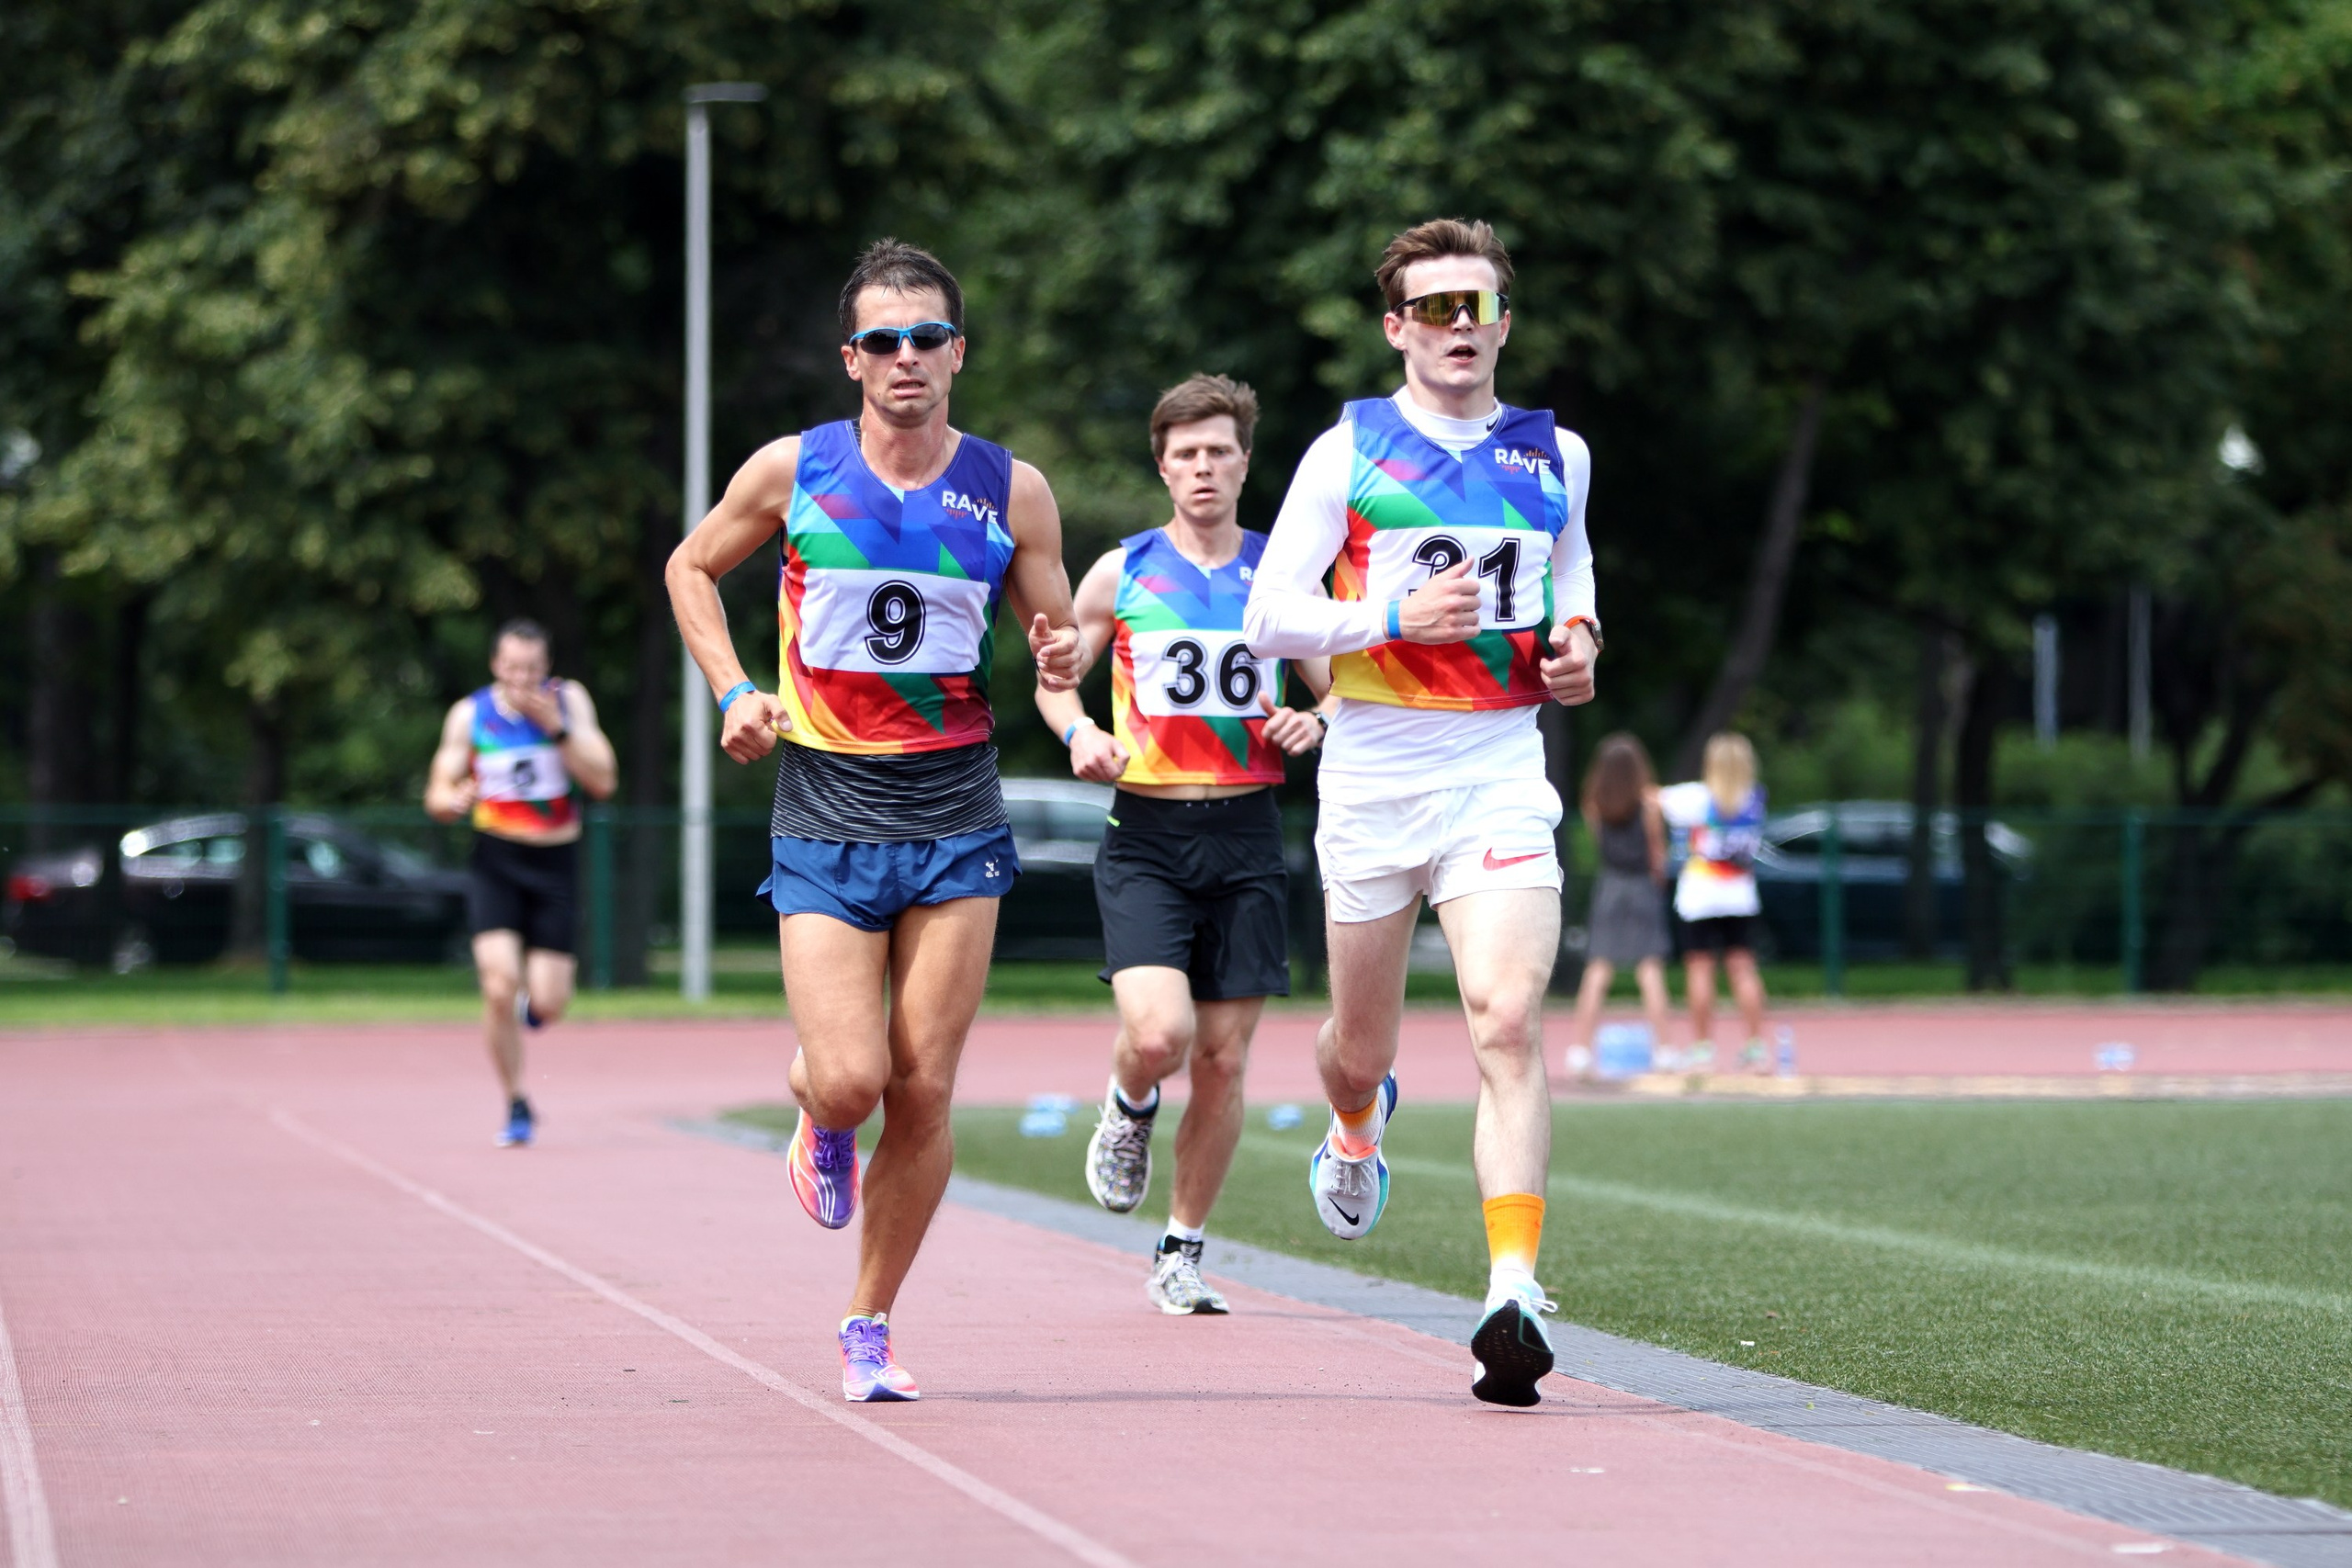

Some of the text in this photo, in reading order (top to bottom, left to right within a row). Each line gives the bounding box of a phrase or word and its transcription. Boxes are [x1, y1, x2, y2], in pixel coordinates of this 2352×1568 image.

[1494, 448, 1551, 475] RAVE
[942, 491, 998, 525] RAVE
[865, 580, 925, 665] 9
[1161, 637, 1262, 711] 36
